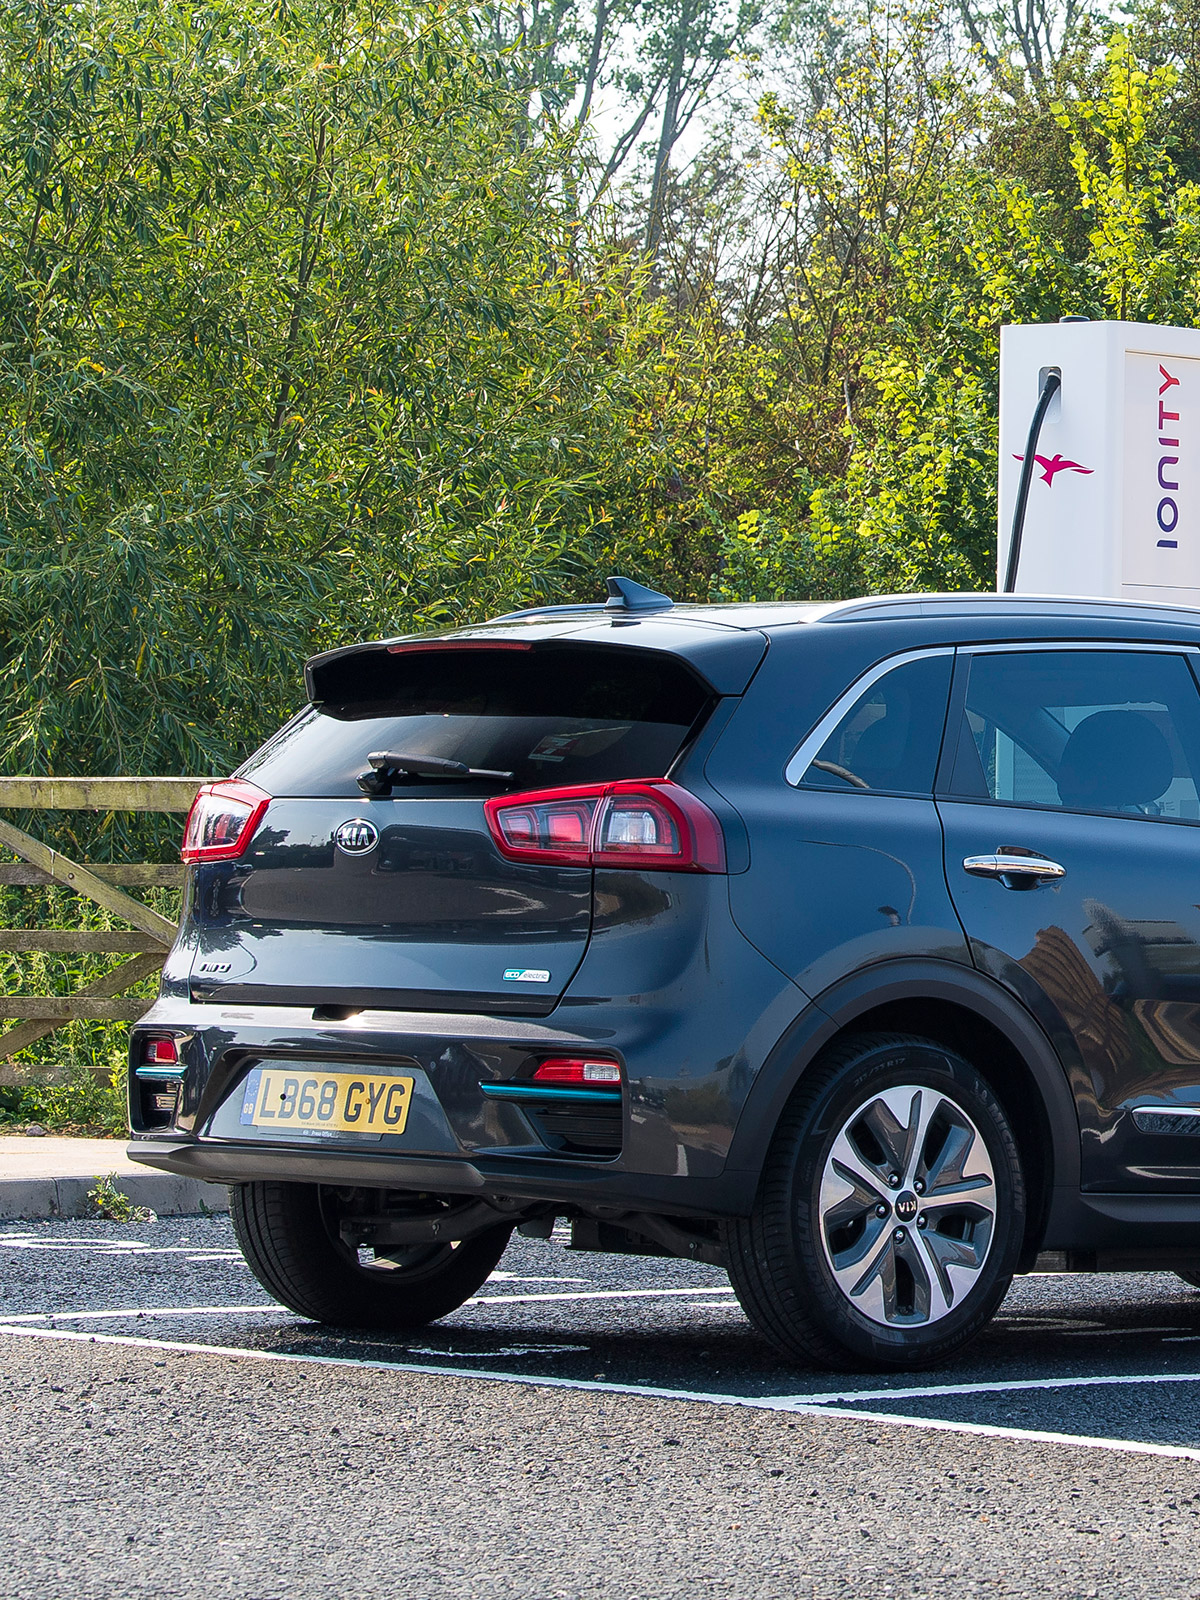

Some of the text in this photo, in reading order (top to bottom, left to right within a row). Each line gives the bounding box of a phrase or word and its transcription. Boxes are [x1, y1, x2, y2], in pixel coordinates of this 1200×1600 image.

[1157, 364, 1180, 548] IONITY
[341, 827, 369, 846] KIA
[243, 1103, 254, 1114] GB
[259, 1078, 405, 1125] LB68 GYG
[988, 1103, 1024, 1213] MICHELIN
[898, 1200, 917, 1213] KIA
